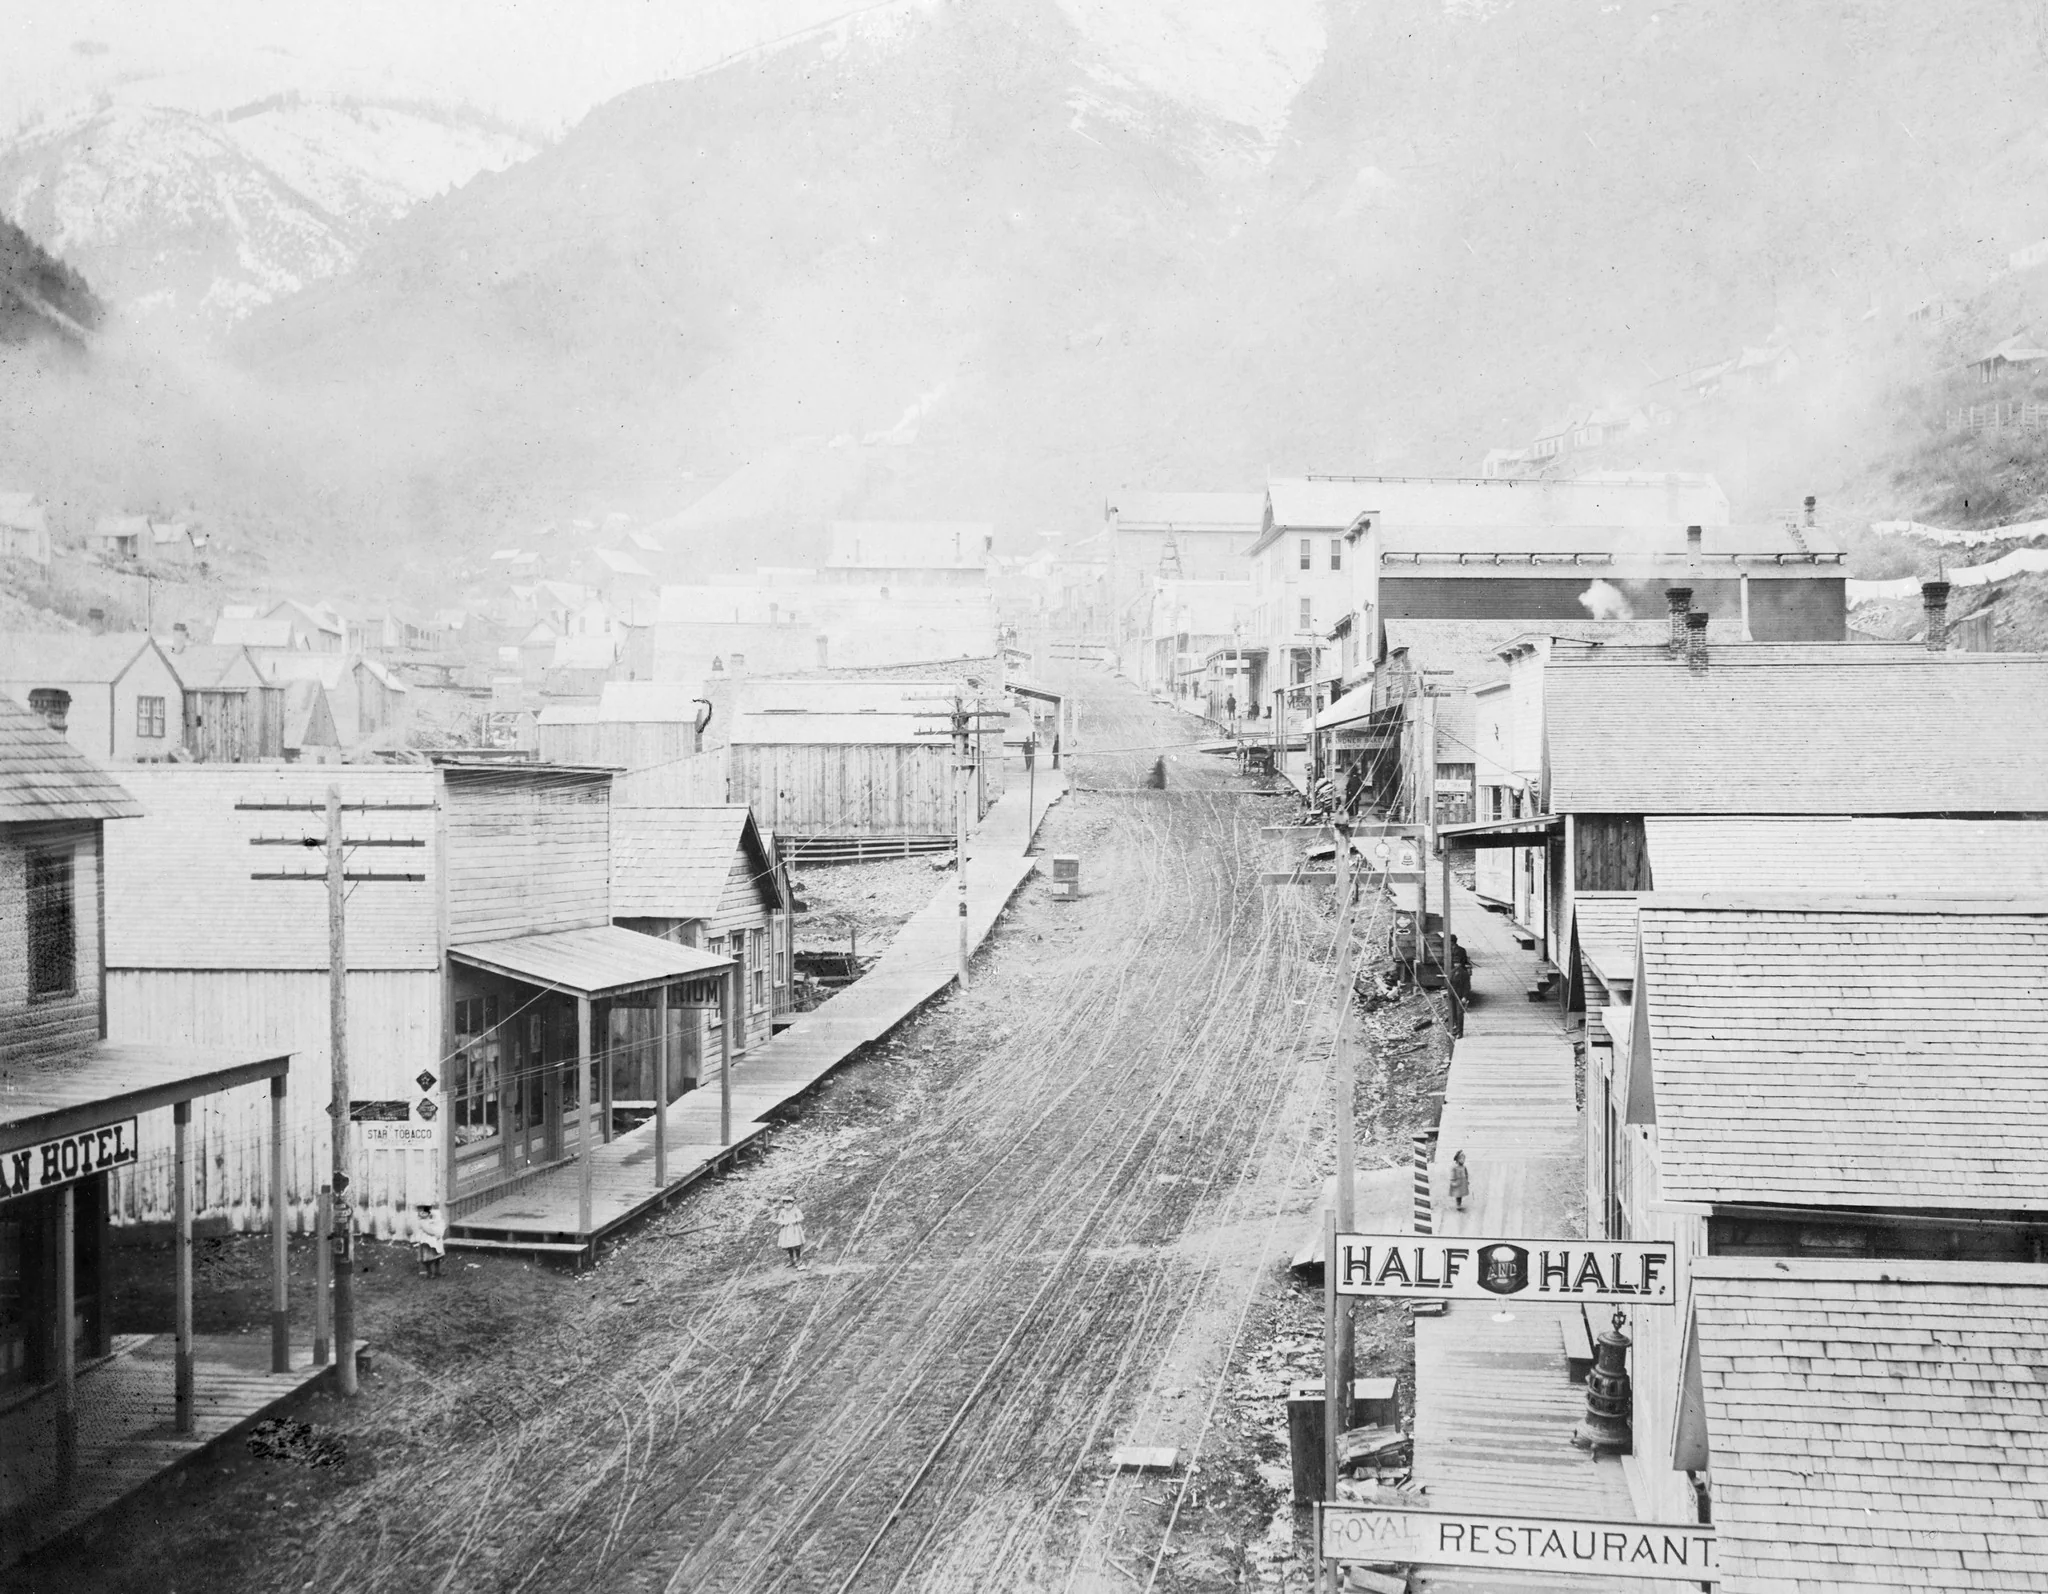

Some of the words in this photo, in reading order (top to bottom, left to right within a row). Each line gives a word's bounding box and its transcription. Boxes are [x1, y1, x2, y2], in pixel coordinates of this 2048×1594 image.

[614, 979, 719, 1005] EMPRIUM
[367, 1129, 388, 1140] STAR
[394, 1129, 433, 1140] TOBACCO
[1342, 1245, 1470, 1289] HALF
[1486, 1262, 1518, 1281] AND
[1328, 1515, 1421, 1549] ROYAL
